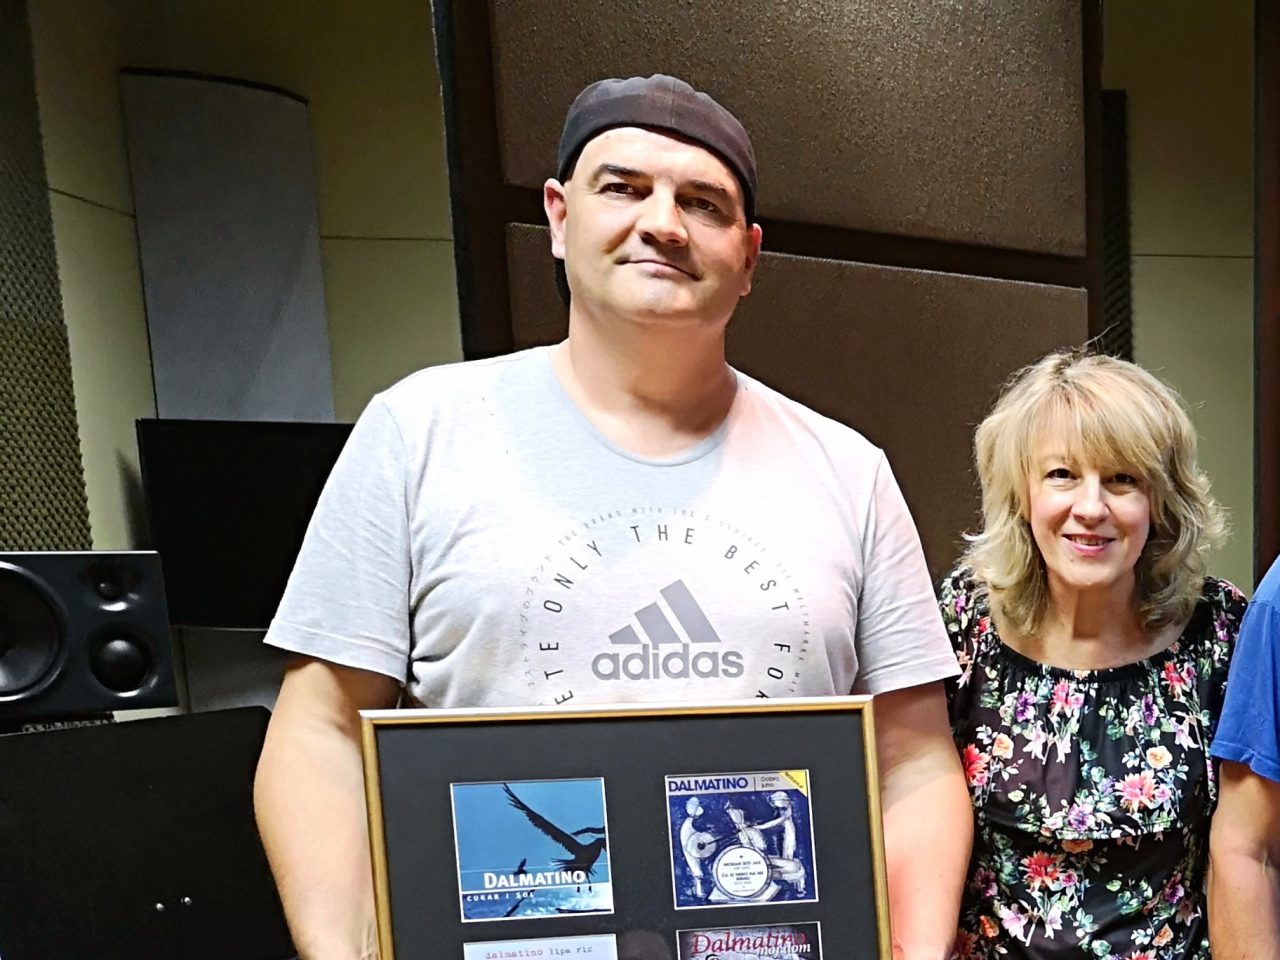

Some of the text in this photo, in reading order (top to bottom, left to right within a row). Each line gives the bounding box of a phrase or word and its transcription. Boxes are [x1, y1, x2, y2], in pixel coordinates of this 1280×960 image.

[543, 540, 602, 613] ONLY
[630, 524, 695, 545] THE
[724, 545, 790, 611] BEST
[591, 642, 744, 681] adidas
[668, 777, 748, 792] DALMATINO
[483, 870, 587, 889] DALMATINO
[466, 894, 500, 902] CUKAR
